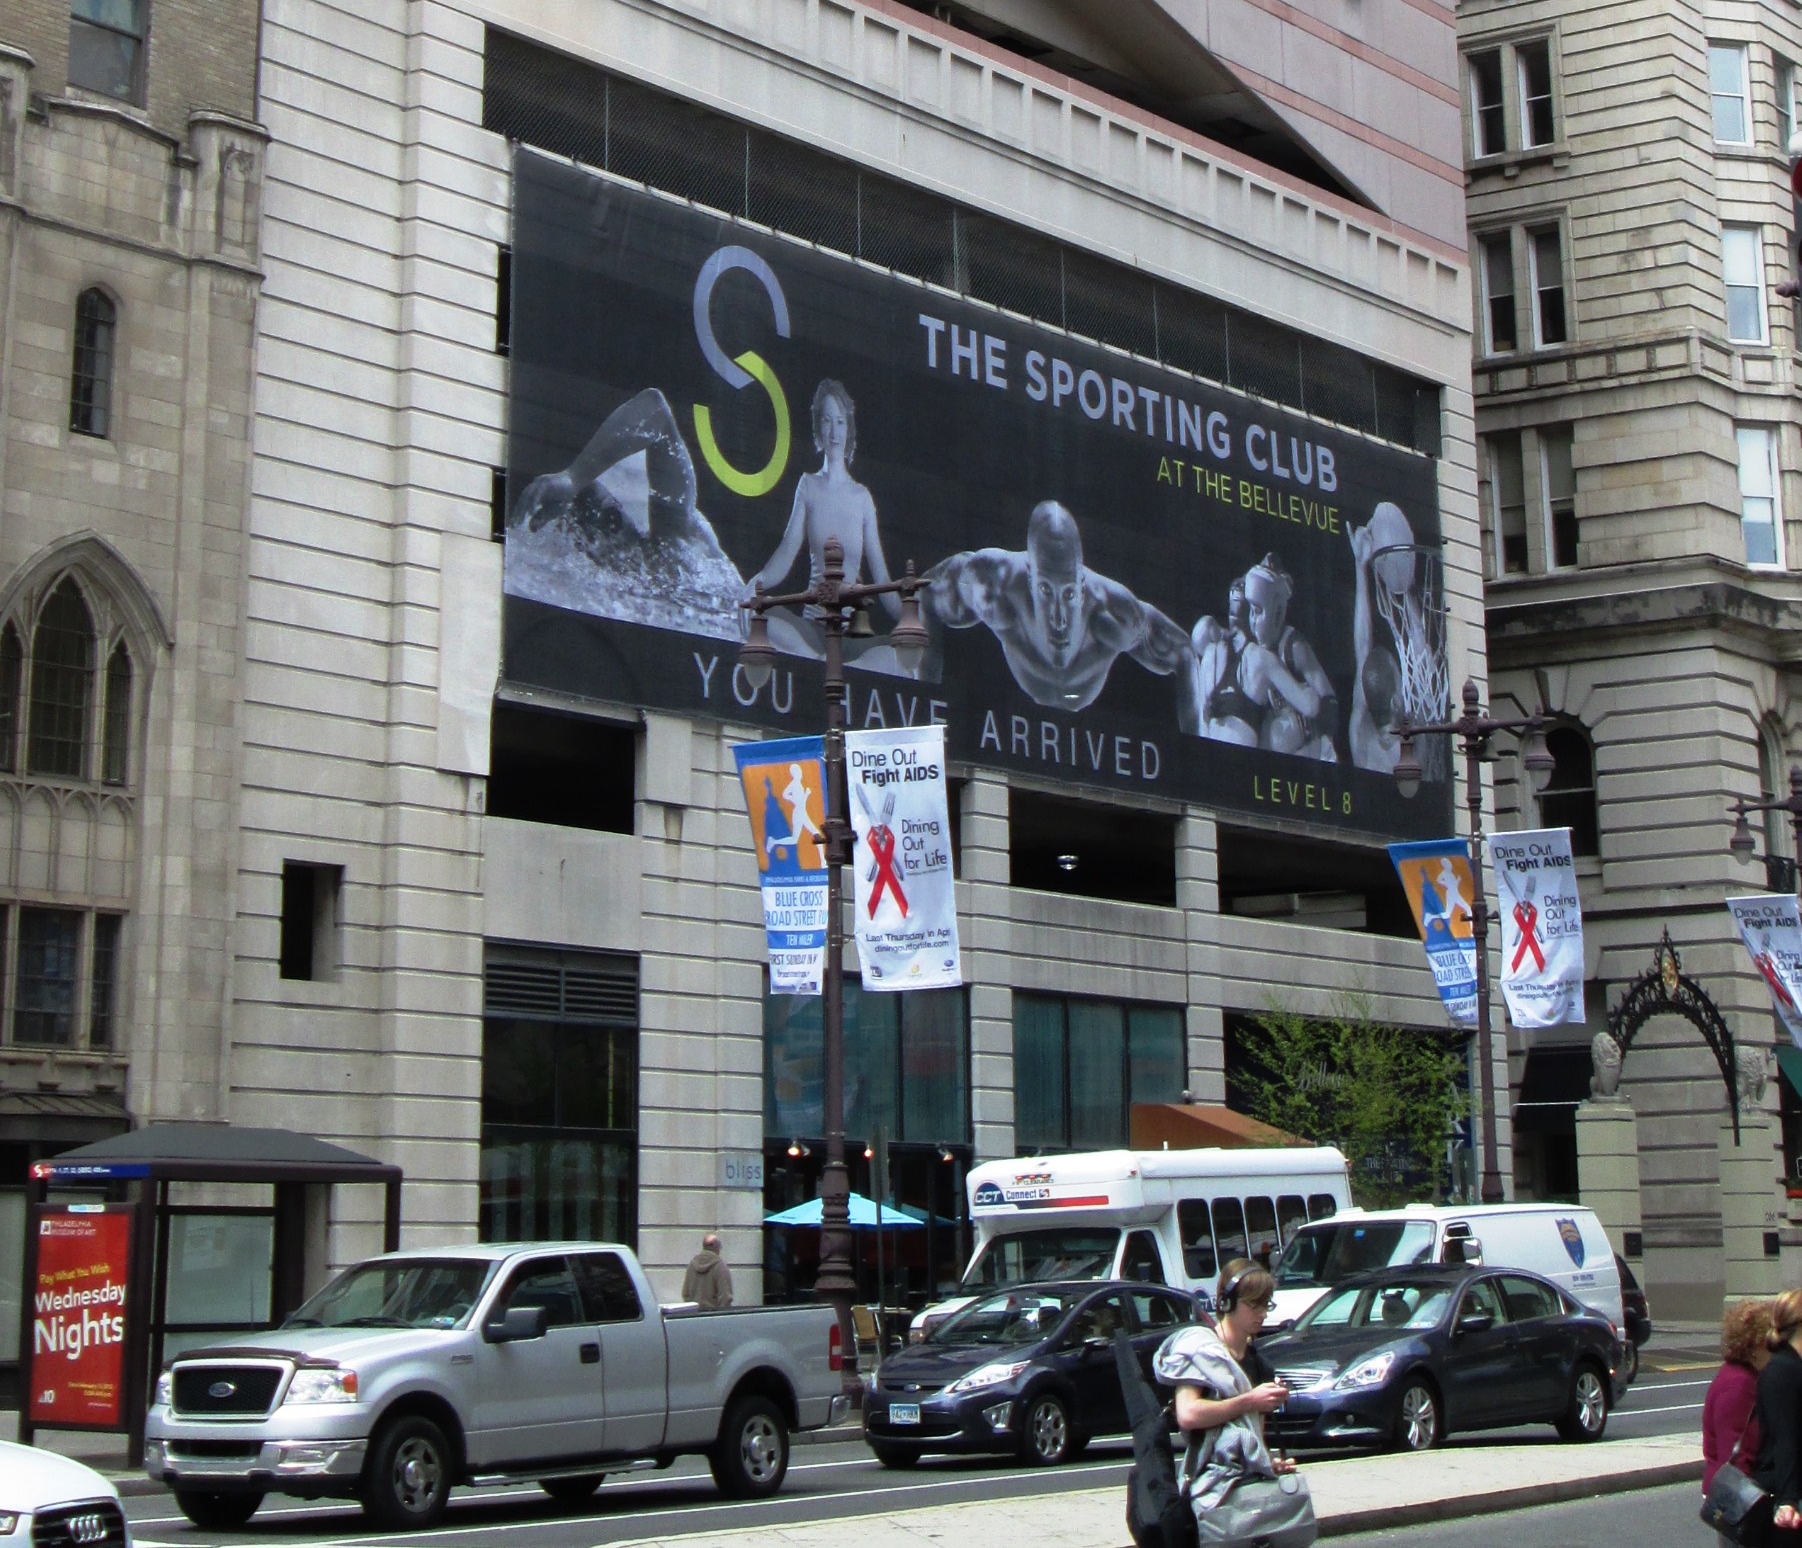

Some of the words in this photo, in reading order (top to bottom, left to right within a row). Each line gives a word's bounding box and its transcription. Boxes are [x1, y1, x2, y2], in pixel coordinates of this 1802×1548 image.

[918, 313, 1008, 390] THE
[1025, 349, 1232, 460] SPORTING
[1245, 424, 1338, 493] CLUB
[1157, 455, 1185, 488] AT
[1193, 465, 1232, 504] THE
[1239, 479, 1341, 535] BELLEVUE
[693, 651, 794, 715] YOU
[980, 710, 1161, 781] ARRIVED
[851, 750, 887, 768] Dine
[891, 748, 917, 766] Out
[861, 767, 900, 787] Fight
[903, 764, 939, 783] AIDS
[1253, 775, 1332, 813] LEVEL
[1341, 791, 1352, 815] 8
[901, 818, 939, 836] Dining
[902, 836, 924, 851] Out
[1494, 846, 1526, 859] Dine
[1528, 843, 1553, 857] Out
[904, 852, 920, 870] for
[924, 848, 947, 867] Life
[1505, 858, 1540, 873] Fight
[1543, 855, 1571, 868] AIDS
[775, 891, 797, 907] BLUE
[800, 890, 823, 907] CROSS
[1544, 895, 1577, 908] Dining
[793, 909, 817, 926] STREET
[1545, 908, 1565, 921] Out
[1734, 907, 1760, 919] Dine
[1762, 905, 1784, 917] Out
[1546, 922, 1560, 935] for
[1744, 918, 1774, 930] Fight
[1775, 917, 1798, 928] AIDS
[866, 933, 883, 942] Last
[885, 931, 924, 941] Thursday
[1436, 953, 1456, 967] BLUE
[725, 1159, 761, 1180] bliss
[975, 1190, 1000, 1203] CCT
[1005, 1189, 1037, 1201] Connect
[39, 1273, 54, 1286] Pay
[55, 1270, 75, 1281] What
[76, 1267, 89, 1278] You
[90, 1263, 110, 1275] Wish
[35, 1279, 127, 1313] Wednesday
[34, 1308, 124, 1360] Nights
